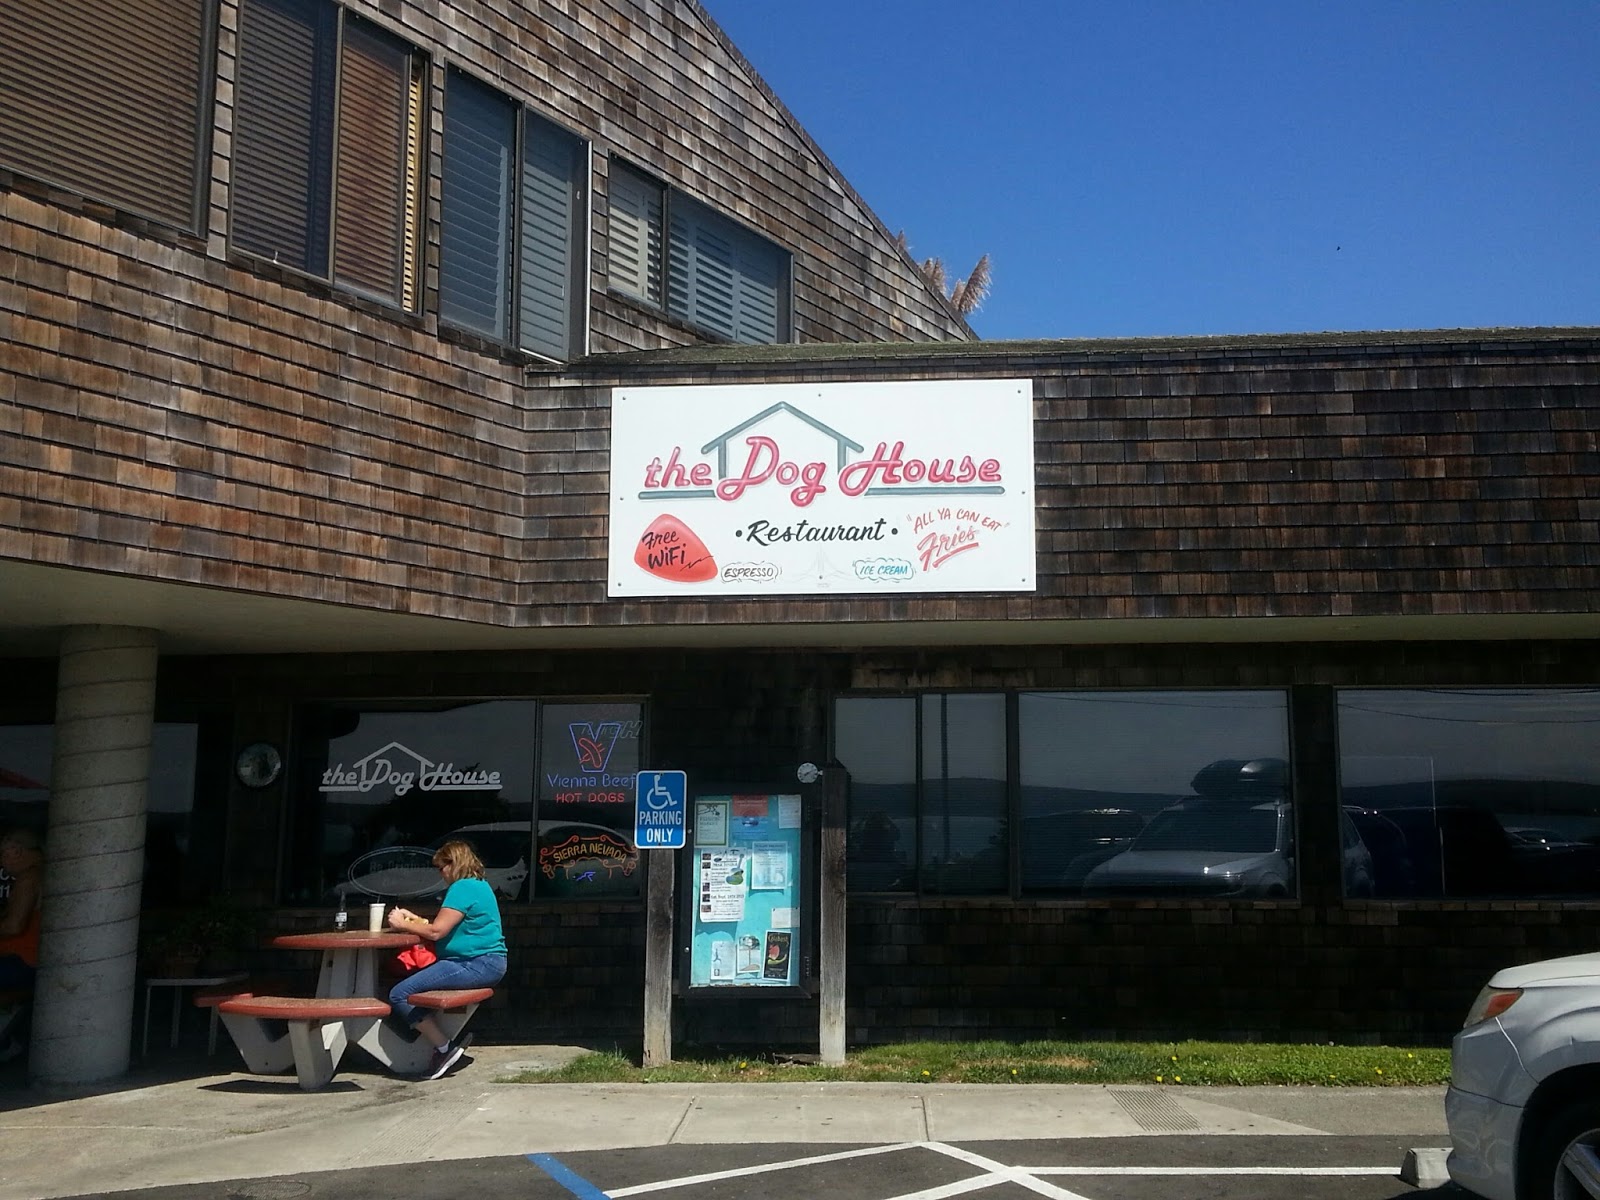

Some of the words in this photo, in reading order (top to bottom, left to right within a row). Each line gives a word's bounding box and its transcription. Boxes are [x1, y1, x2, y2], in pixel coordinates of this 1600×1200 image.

[644, 446, 713, 488] the
[716, 435, 827, 508] Dog
[838, 440, 1002, 497] House
[937, 507, 951, 521] YA
[956, 508, 980, 523] CAN
[641, 530, 680, 550] Free
[746, 518, 887, 547] Restaurant
[916, 526, 980, 572] Fries
[723, 567, 774, 579] ESPRESSO
[859, 565, 875, 576] ICE
[877, 565, 908, 576] CREAM
[322, 763, 358, 785] the
[358, 758, 415, 796] Dog
[418, 762, 501, 791] House
[547, 773, 597, 788] Vienna
[602, 773, 636, 789] Beef
[555, 792, 583, 804] HOT
[588, 792, 625, 803] DOGS
[639, 810, 682, 826] PARKING
[646, 828, 674, 843] ONLY
[553, 844, 588, 863] SIERRA
[589, 842, 627, 864] NEVADA
